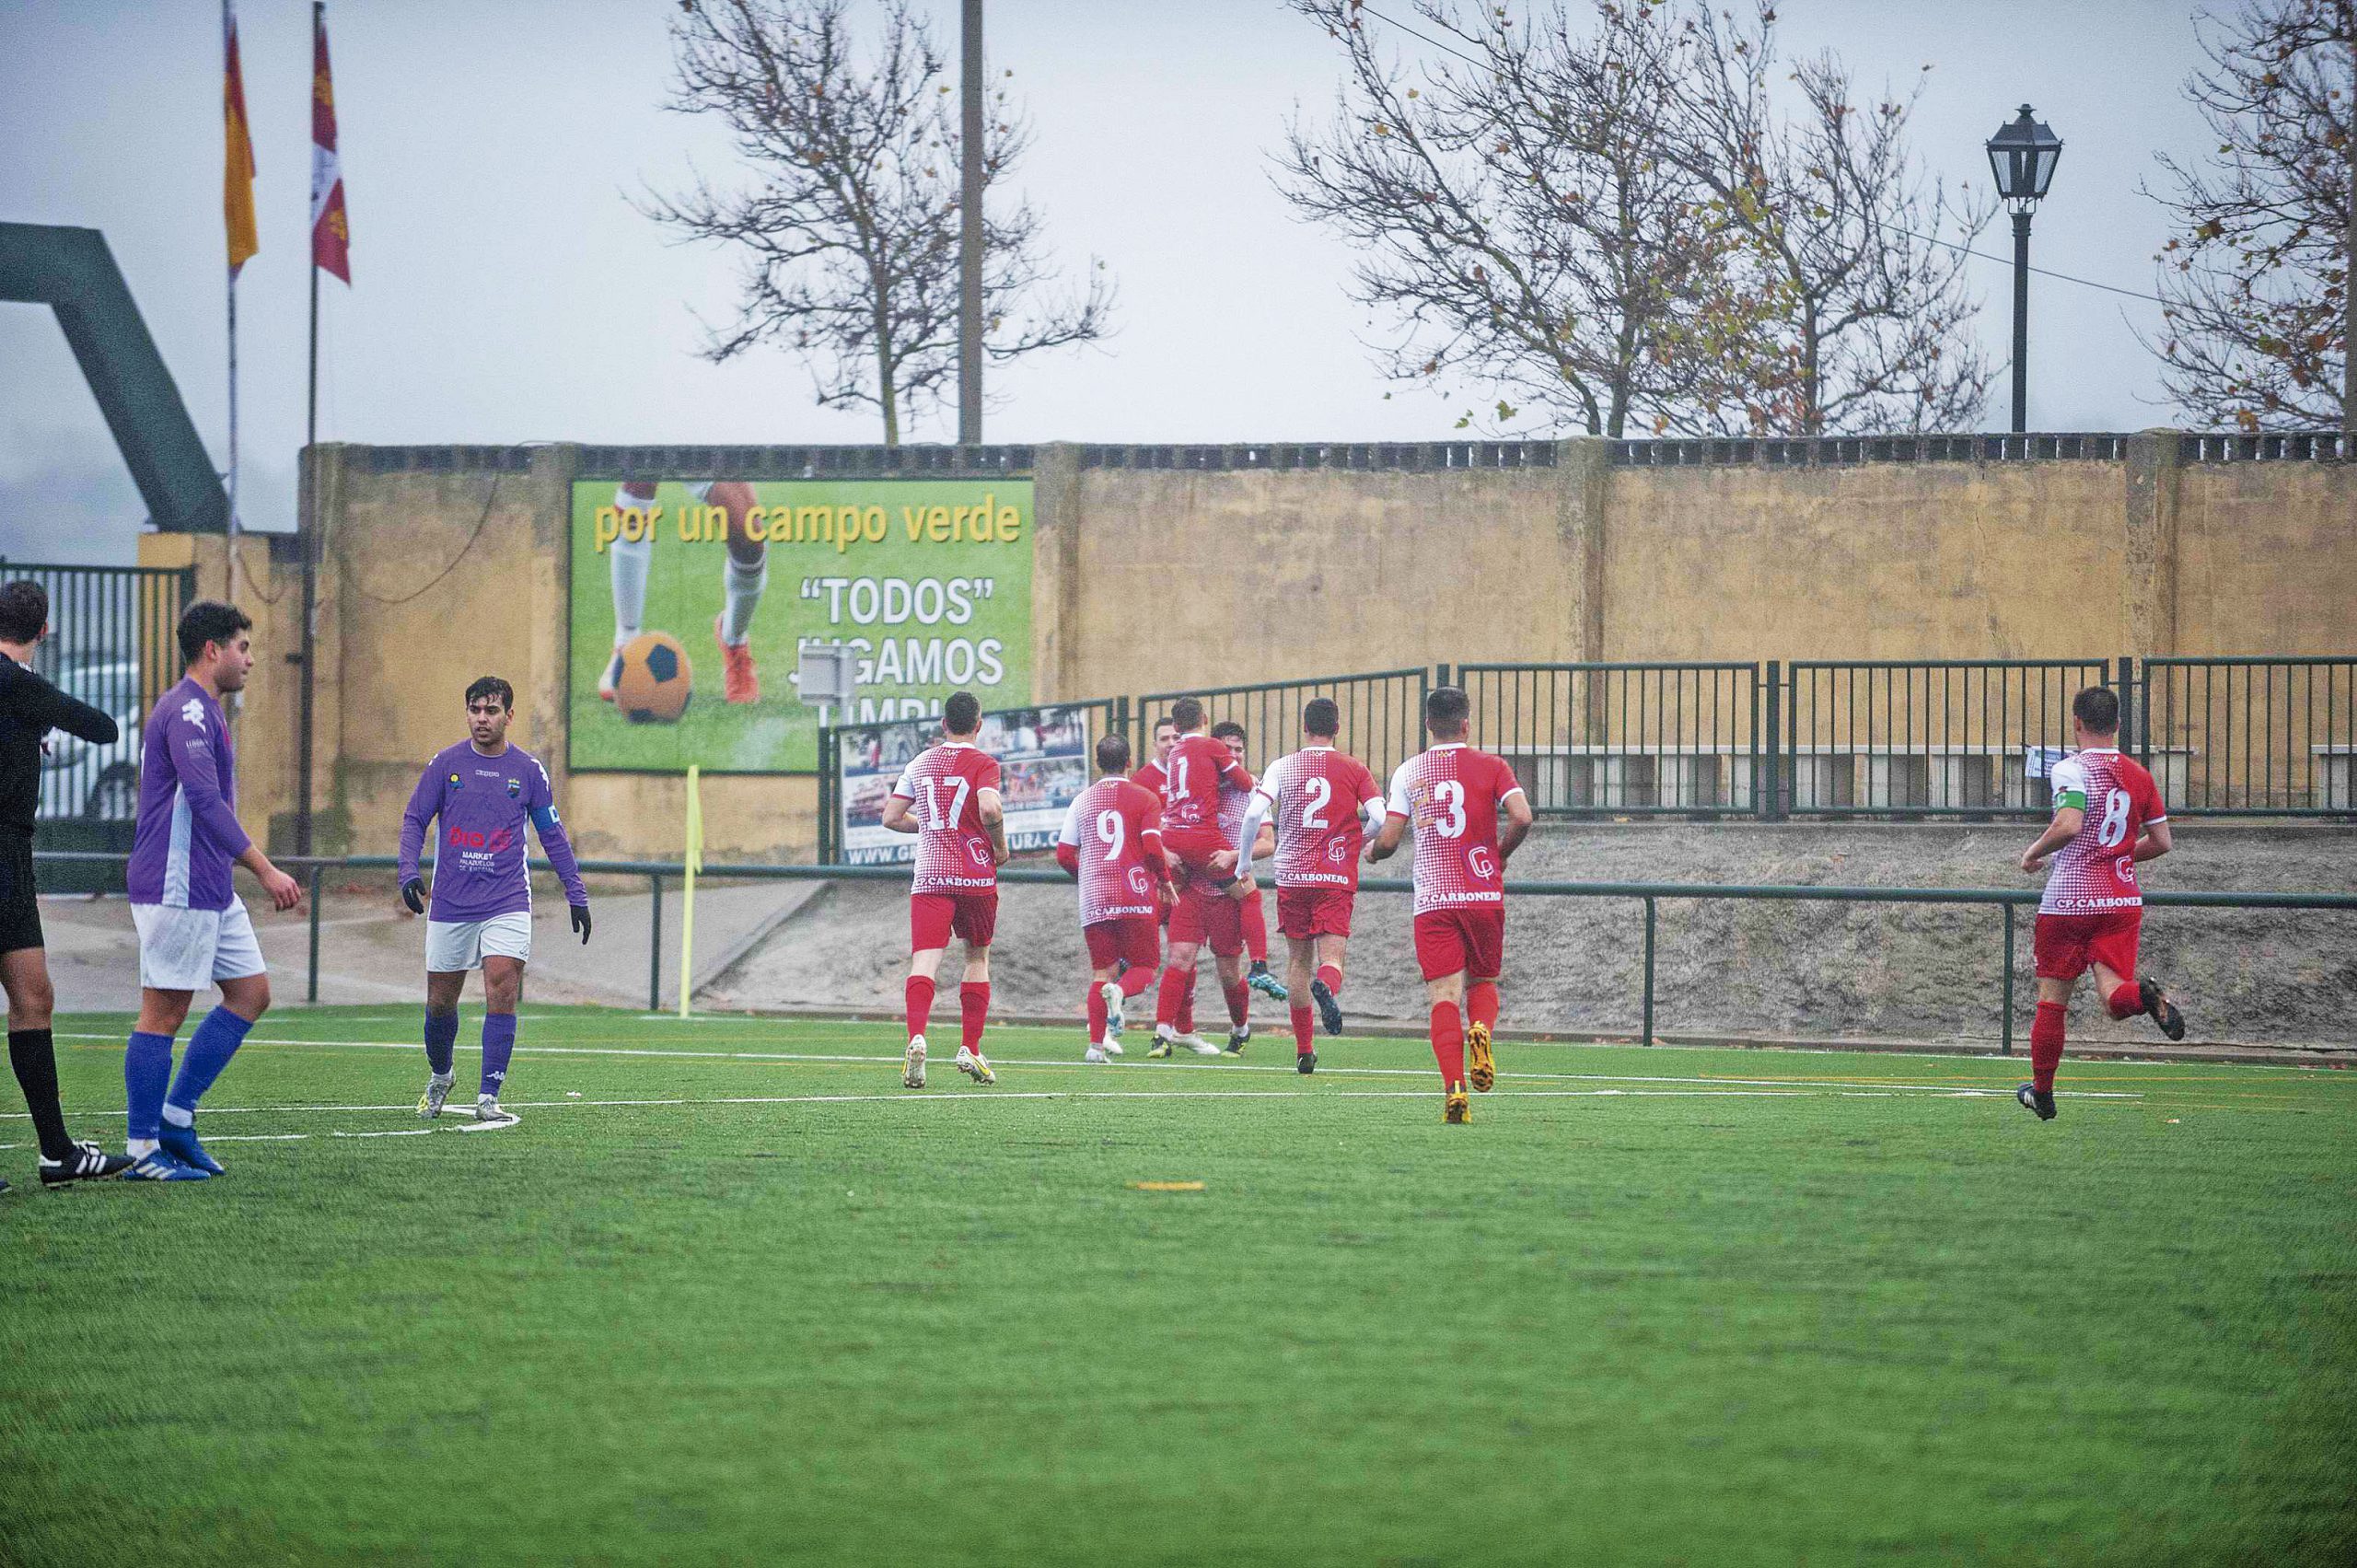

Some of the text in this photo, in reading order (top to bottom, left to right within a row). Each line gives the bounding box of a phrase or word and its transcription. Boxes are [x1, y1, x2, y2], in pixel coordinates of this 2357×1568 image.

[595, 494, 1021, 552] por un campo verde
[922, 776, 970, 830] 17
[1303, 777, 1331, 829] 2
[1434, 780, 1467, 839] 3
[2097, 787, 2131, 848] 8
[462, 852, 494, 861] MARKET
[1097, 809, 1125, 861] 9
